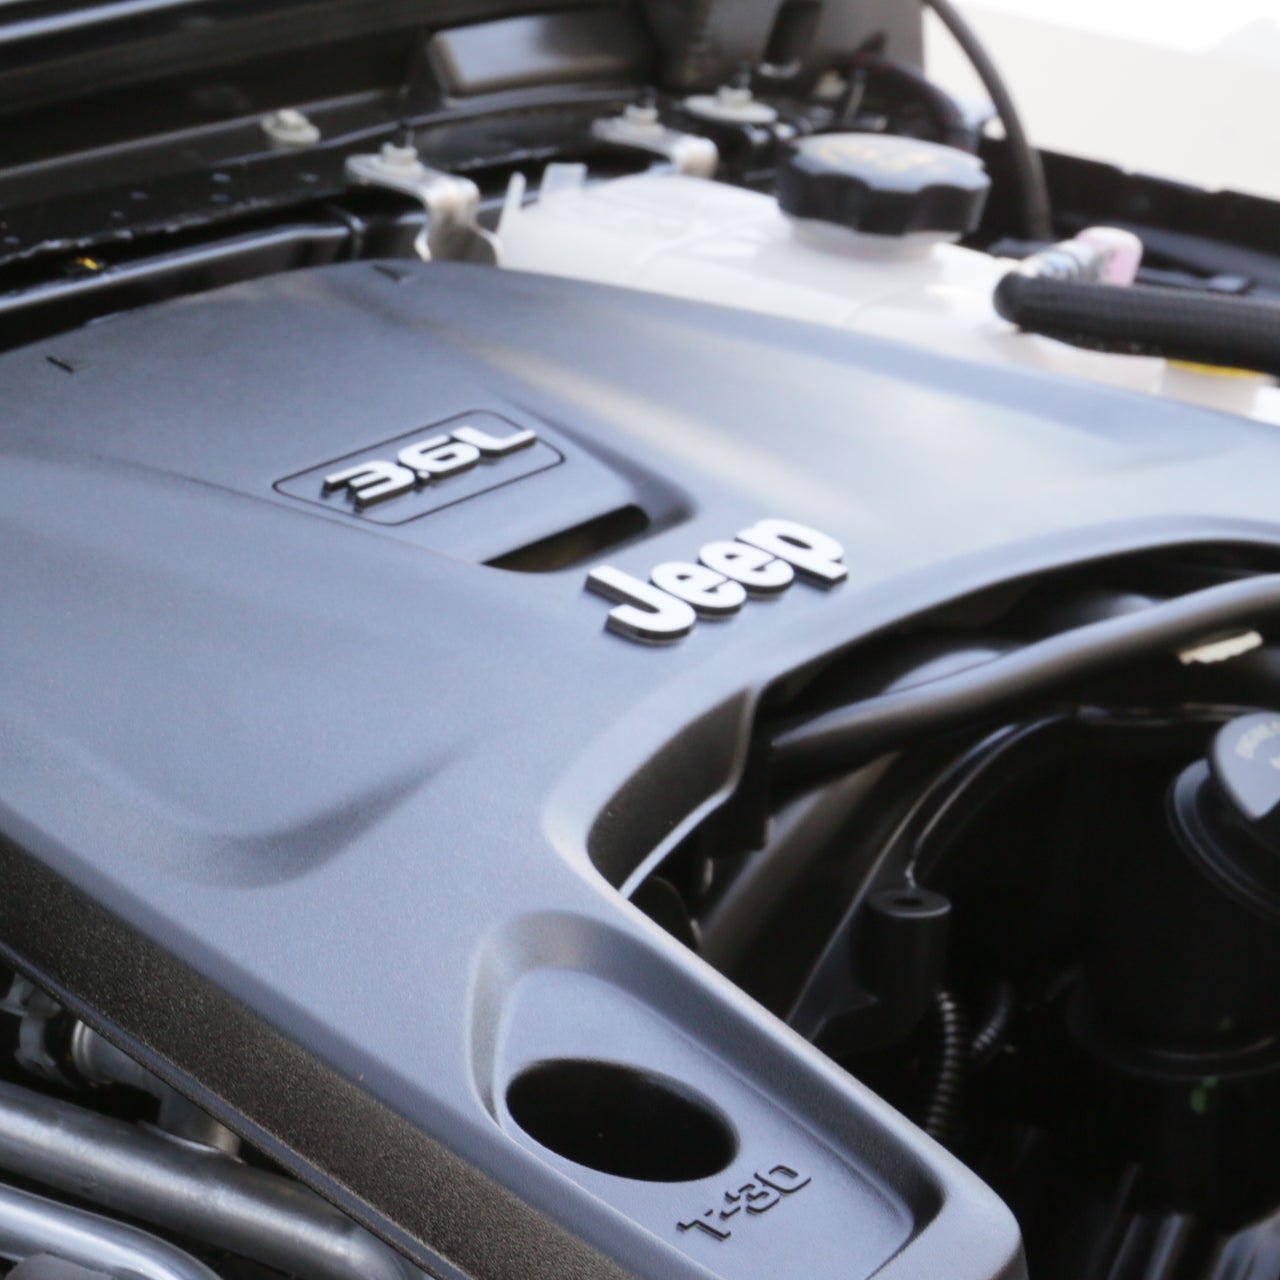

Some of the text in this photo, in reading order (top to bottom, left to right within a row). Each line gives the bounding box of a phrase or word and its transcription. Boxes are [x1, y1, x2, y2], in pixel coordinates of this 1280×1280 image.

[323, 426, 536, 510] 3.6L
[584, 518, 849, 648] Jeep
[676, 1165, 812, 1240] T-30
